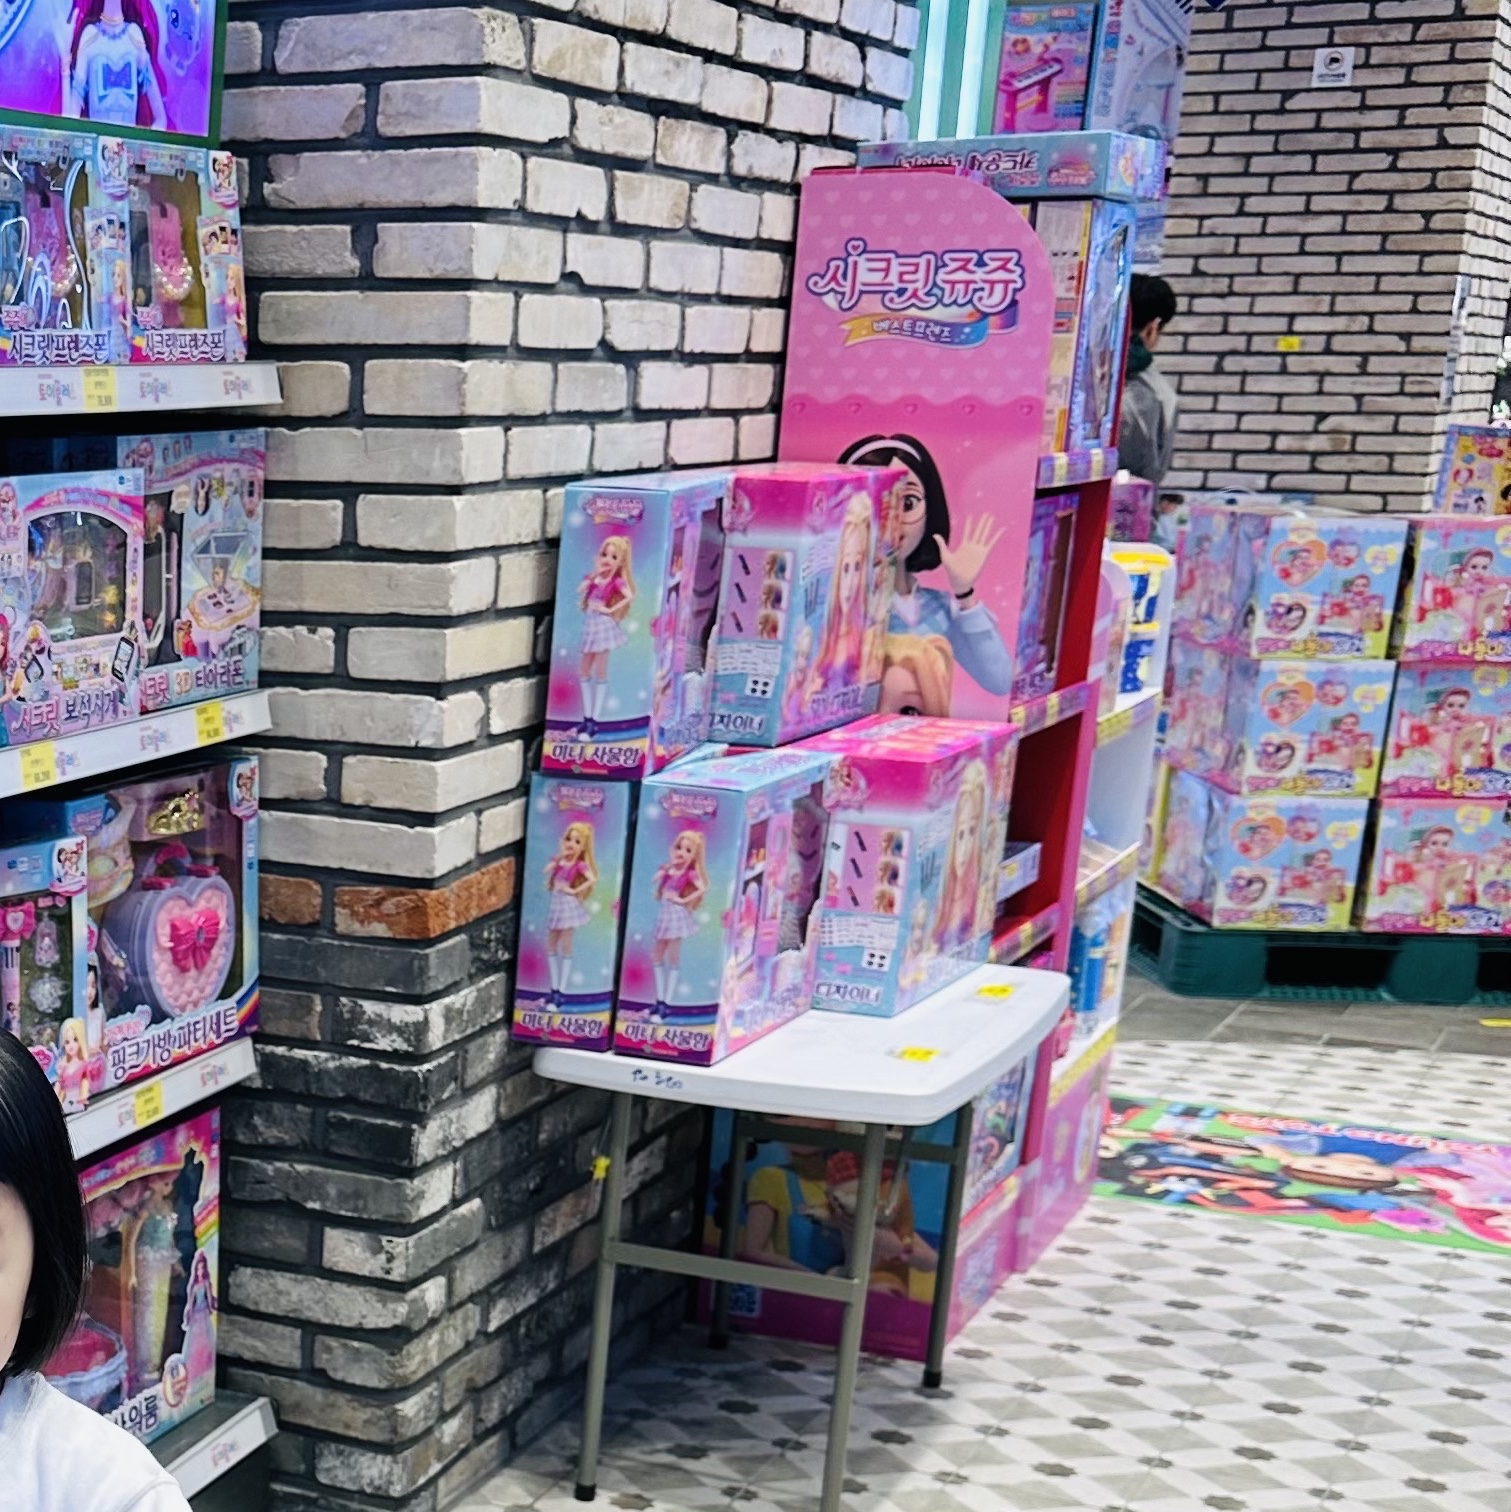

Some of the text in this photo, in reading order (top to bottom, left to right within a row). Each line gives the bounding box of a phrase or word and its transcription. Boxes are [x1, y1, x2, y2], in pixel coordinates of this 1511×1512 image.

[809, 241, 1025, 313] 시크릿 쥬쥬
[870, 317, 952, 343] 베스트프렌즈
[11, 700, 61, 738] 시크릿
[551, 743, 640, 767] 미니 사물함
[521, 1013, 553, 1031] 미니
[623, 1023, 656, 1043] 미니
[112, 1004, 238, 1082] 핑크가방 파티세트
